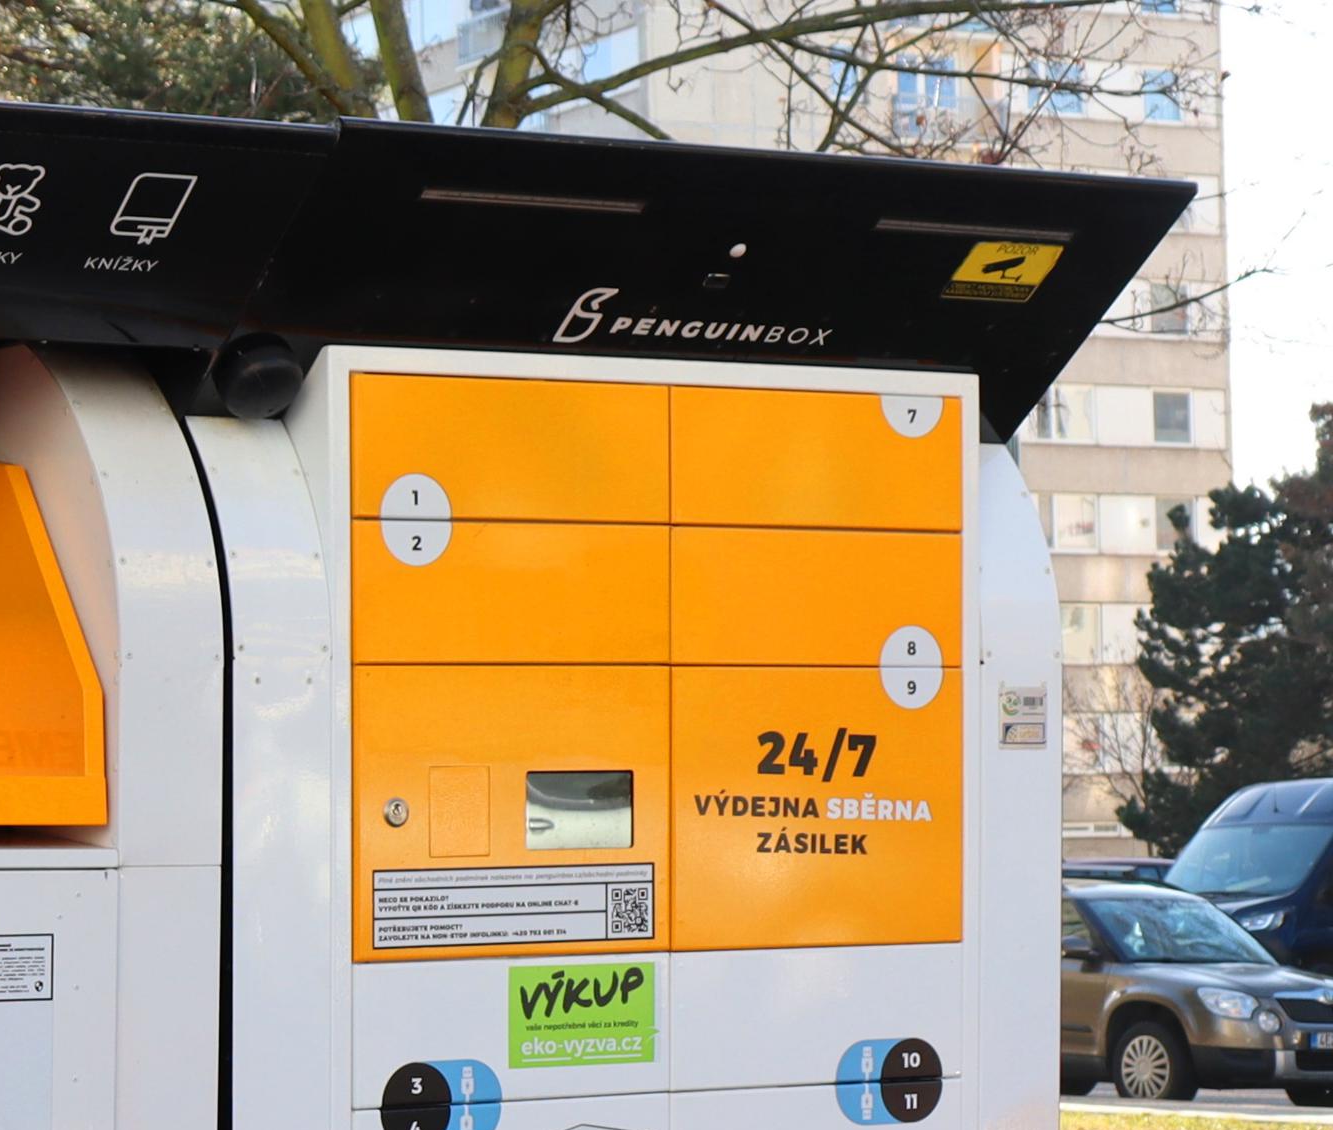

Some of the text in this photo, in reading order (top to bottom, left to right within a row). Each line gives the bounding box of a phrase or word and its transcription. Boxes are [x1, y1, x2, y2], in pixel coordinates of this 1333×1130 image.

[996, 244, 1040, 255] POZOR
[83, 255, 159, 272] KNÍŽKY
[609, 317, 833, 346] PENGUINBOX
[907, 409, 917, 423] 7
[411, 490, 419, 505] 1
[411, 535, 422, 551] 2
[907, 641, 917, 656] 8
[907, 681, 917, 695] 9
[757, 728, 877, 782] 24/7
[694, 789, 933, 821] VÝDEJNA SBĚRNA
[757, 827, 868, 855] ZÁSILEK
[520, 967, 644, 1020] VÝKUP
[521, 1036, 642, 1057] eko-vyzva.cz
[901, 1052, 921, 1068] 10
[411, 1077, 423, 1095] 3
[904, 1093, 918, 1110] 11
